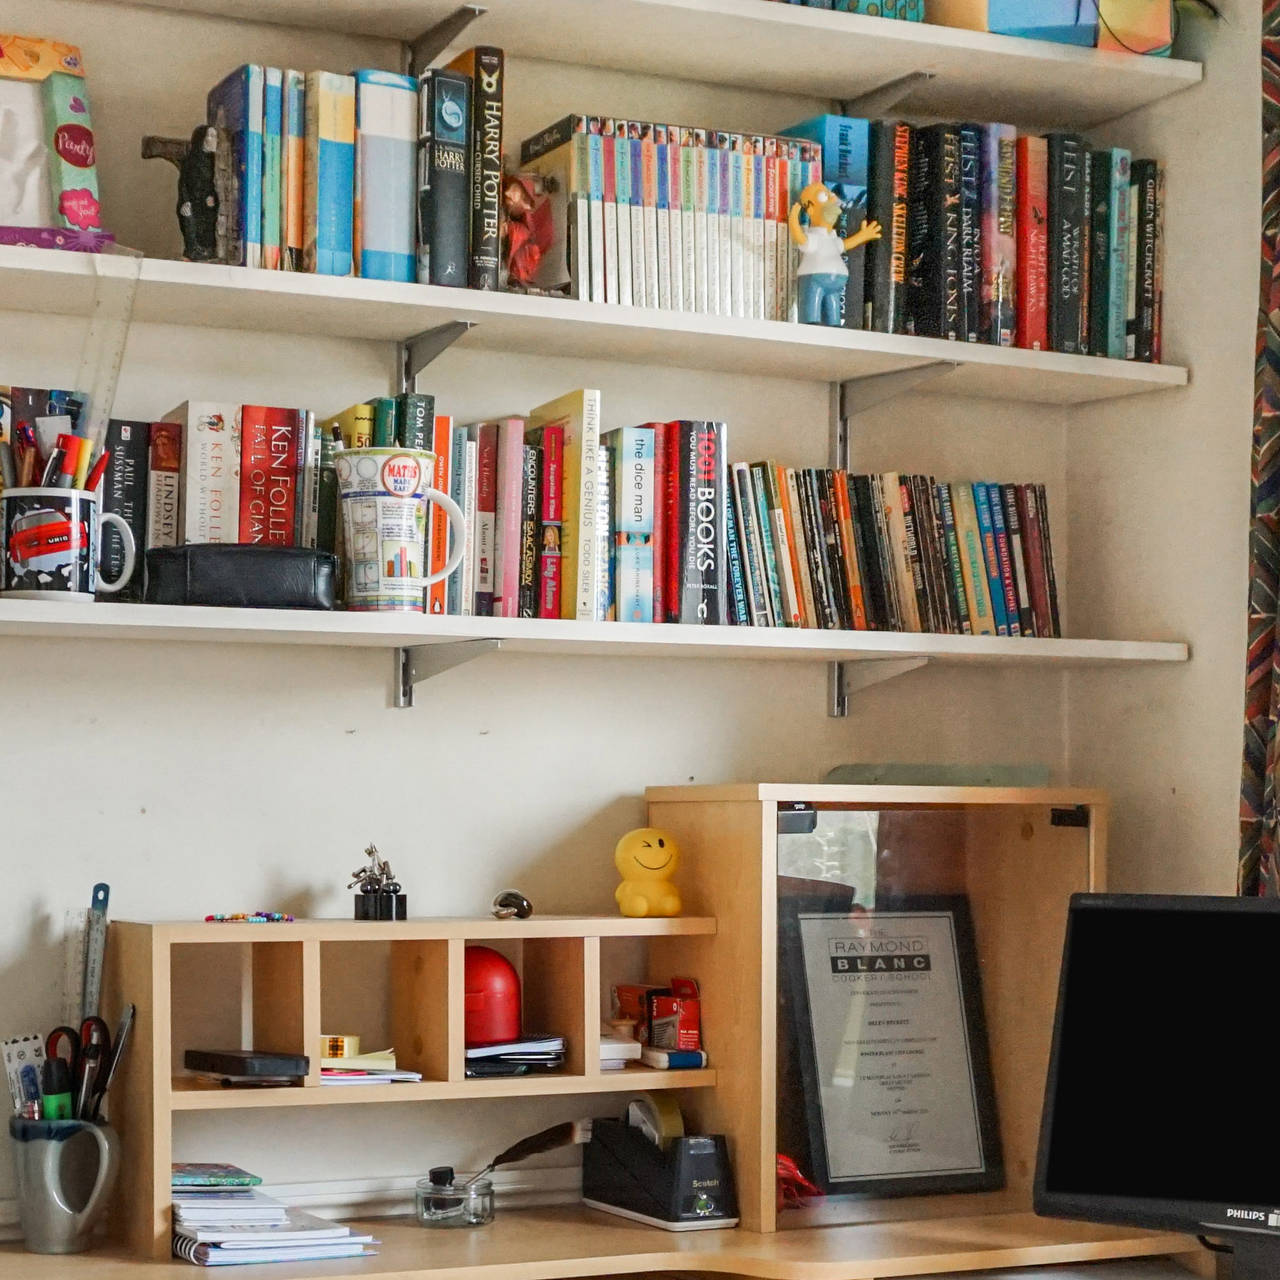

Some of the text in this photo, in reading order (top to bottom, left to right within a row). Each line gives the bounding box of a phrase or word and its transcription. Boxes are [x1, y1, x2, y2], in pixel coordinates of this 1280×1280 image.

[435, 150, 463, 163] HARRY
[484, 100, 503, 164] HARRY
[944, 133, 958, 184] FEIST
[435, 159, 465, 171] POTTER
[473, 152, 482, 209] CURSED CHILD
[894, 125, 909, 198] STEPHEN KING
[961, 130, 975, 188] FEIST
[1062, 140, 1078, 193] FEIST
[482, 168, 501, 241] POTTER
[891, 202, 907, 283] SKELETON CREW
[962, 208, 973, 292] DARK REALM
[1143, 179, 1154, 299] GREEN WITCHCRAFT
[1062, 268, 1072, 299] GOD
[356, 434, 371, 448] 50
[415, 401, 428, 429] TOM
[112, 446, 124, 499] SUSSMAN
[123, 459, 136, 487] PAUL
[250, 424, 267, 496] FALL OF
[270, 425, 292, 468] KEN
[387, 464, 418, 479] MATHS
[438, 455, 446, 472] OWEN
[154, 473, 163, 525] SHADOWS
[161, 475, 175, 537] LINDSEY
[197, 442, 208, 538] WORLD WITHOUT
[209, 442, 224, 543] KEN FOLLE
[480, 466, 490, 498] Hornby
[526, 450, 536, 515] ENCOUNTERS
[582, 399, 597, 594] THINK LIKE GENIUS TODD SILER
[633, 438, 646, 523] the dice man
[687, 431, 697, 570] YOU MUST READ BEFORE YOU DIE
[696, 430, 717, 571] 1001 BOOKS
[481, 520, 489, 549] About
[524, 521, 535, 586] ISAAC ASIMOV
[986, 533, 998, 577] FOUNDATION
[544, 557, 556, 610] Lily Alone
[729, 542, 747, 622] THE FOREVER WAR
[999, 533, 1015, 612] FOUNDATION EMPIRE
[834, 940, 924, 954] RAYMOND
[836, 956, 926, 971] BLANC
[888, 971, 931, 981] SCHOOL
[692, 1180, 720, 1188] Scotch
[1226, 1209, 1266, 1221] PHILIPS
